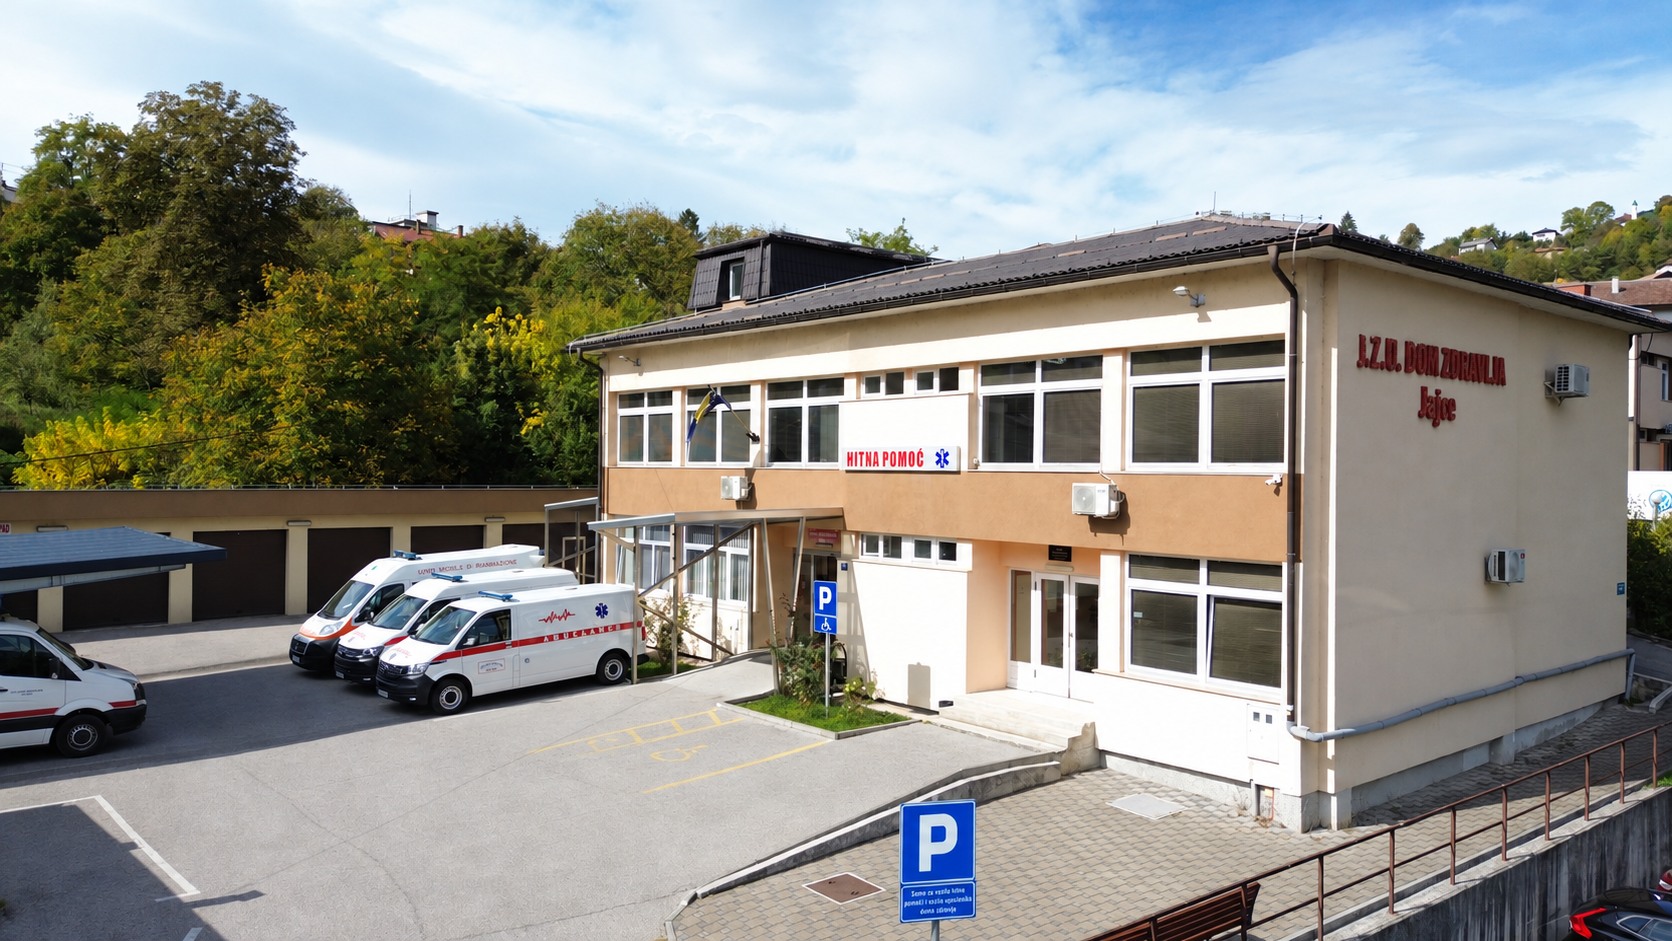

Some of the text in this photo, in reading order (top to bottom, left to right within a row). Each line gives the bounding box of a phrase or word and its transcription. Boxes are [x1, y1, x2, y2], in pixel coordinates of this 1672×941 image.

[1404, 341, 1439, 377] DOM
[1440, 347, 1506, 386] ZDRAVLJA
[1417, 386, 1456, 427] Jajce
[847, 448, 924, 468] HITNA POMOĆ
[819, 586, 832, 610] P
[918, 813, 958, 872] P
